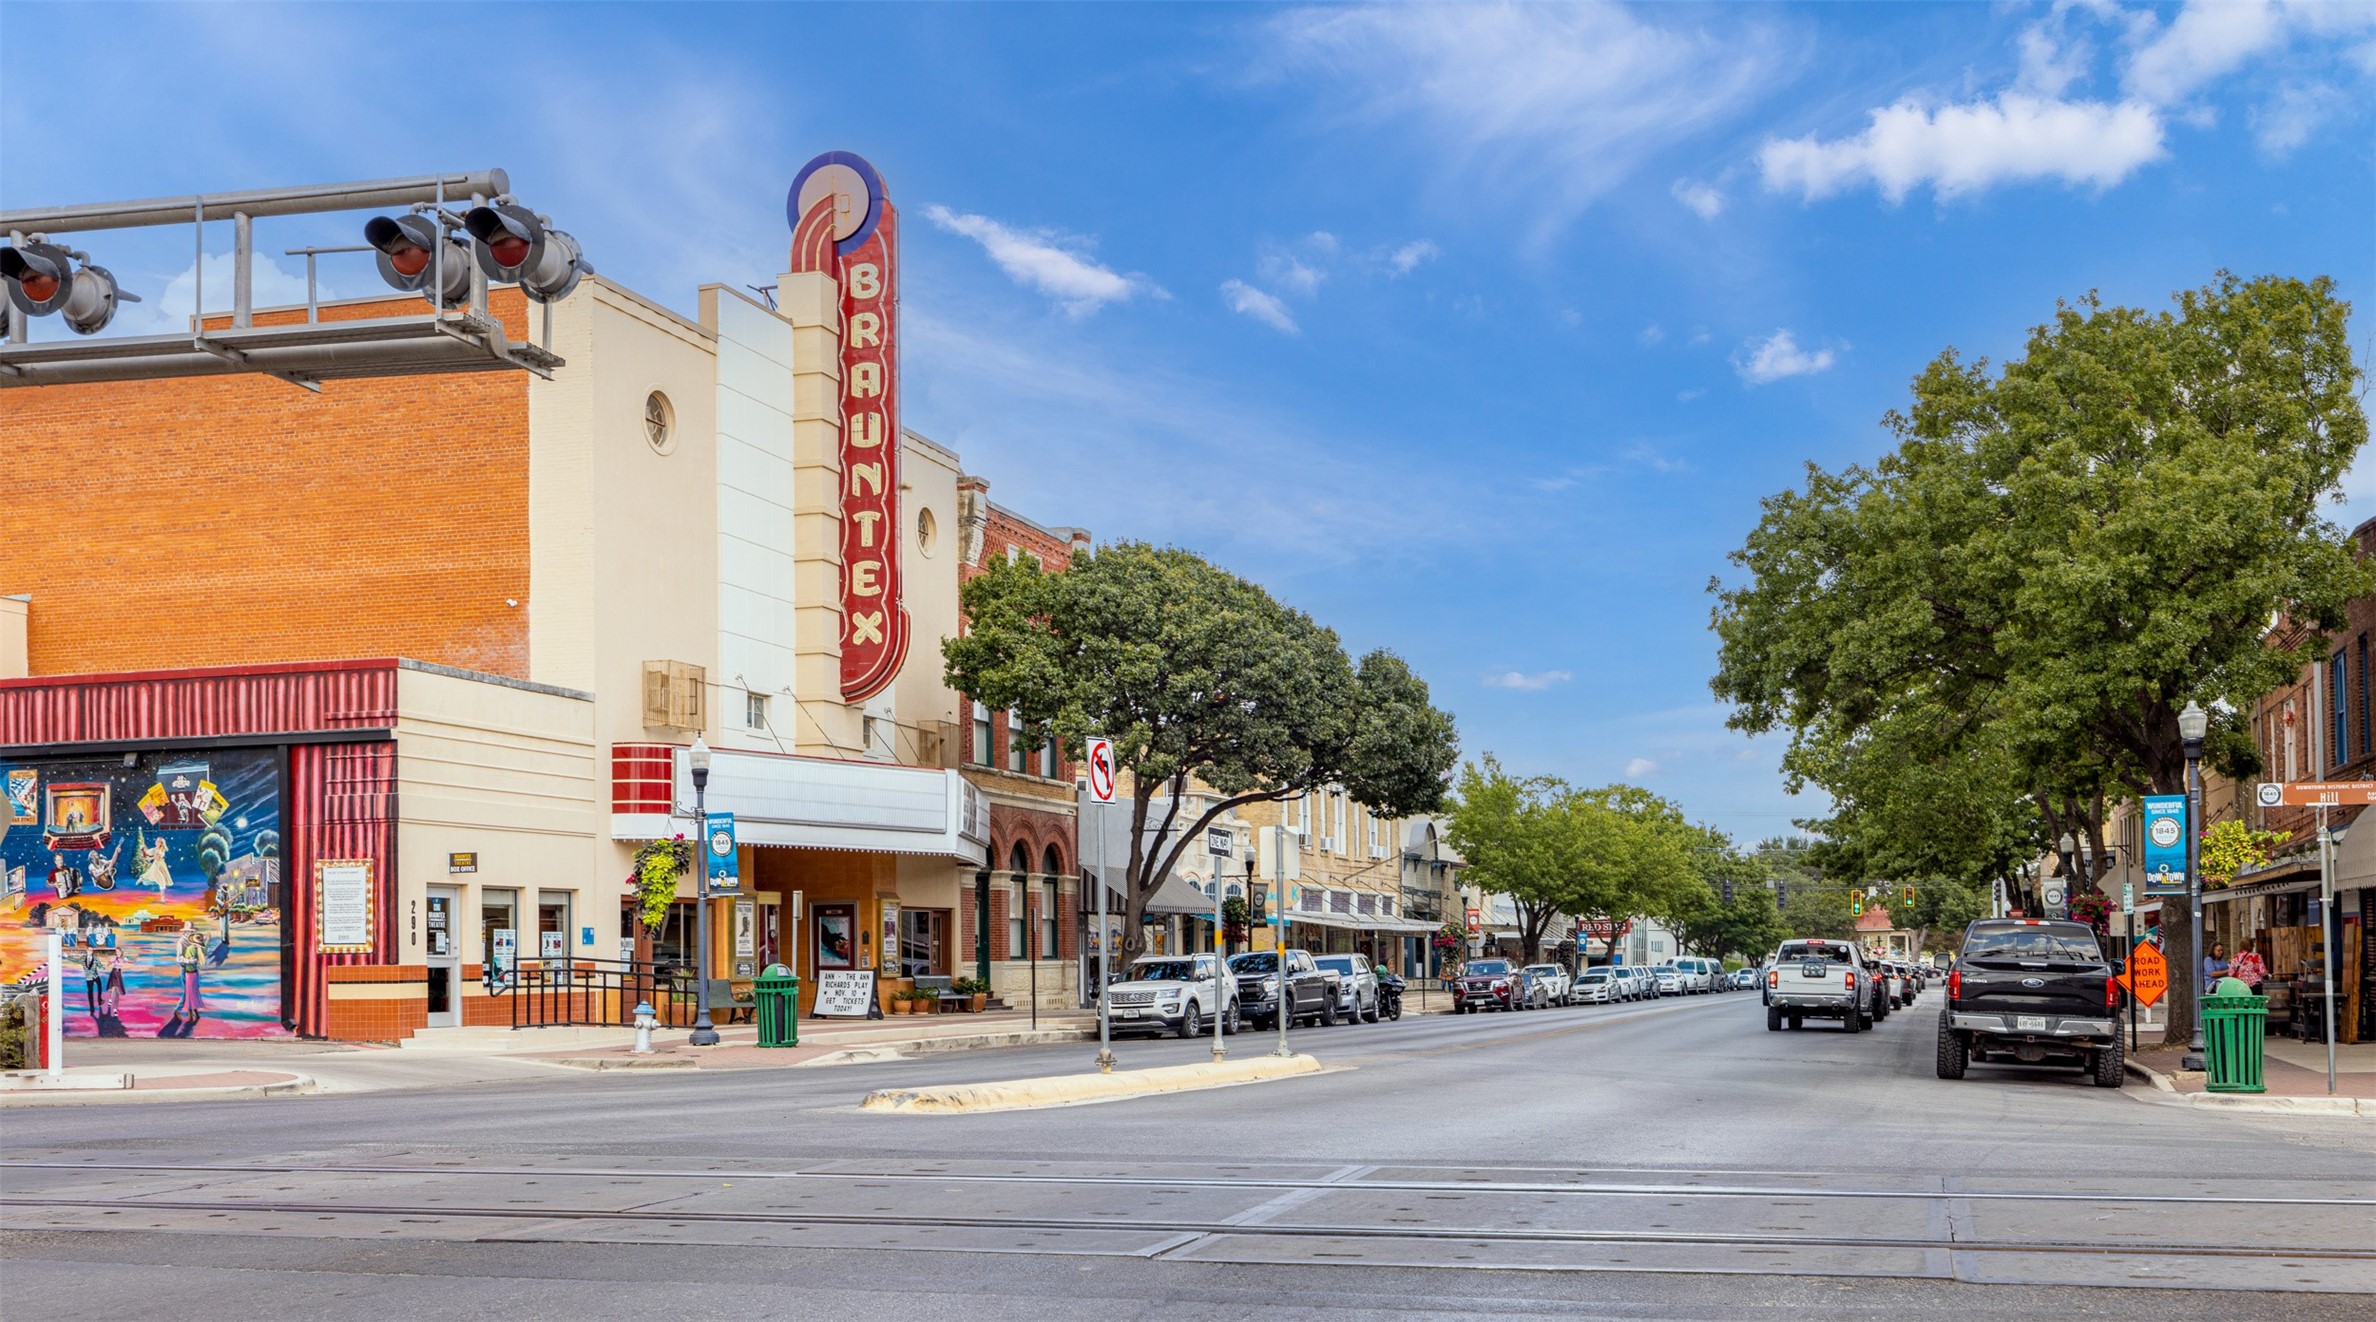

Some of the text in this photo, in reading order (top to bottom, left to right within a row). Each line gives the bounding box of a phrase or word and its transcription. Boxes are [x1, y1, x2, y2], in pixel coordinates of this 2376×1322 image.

[850, 262, 882, 646] BRAUNTEX
[2320, 791, 2339, 803] Hill
[2147, 871, 2185, 884] DOWNTOWN
[1582, 923, 1602, 931] RED
[2134, 957, 2160, 965] ROAD
[2134, 968, 2161, 977] WORK
[854, 981, 868, 989] PLAY
[2134, 980, 2165, 988] AHEAD
[843, 997, 864, 1005] TICKETS
